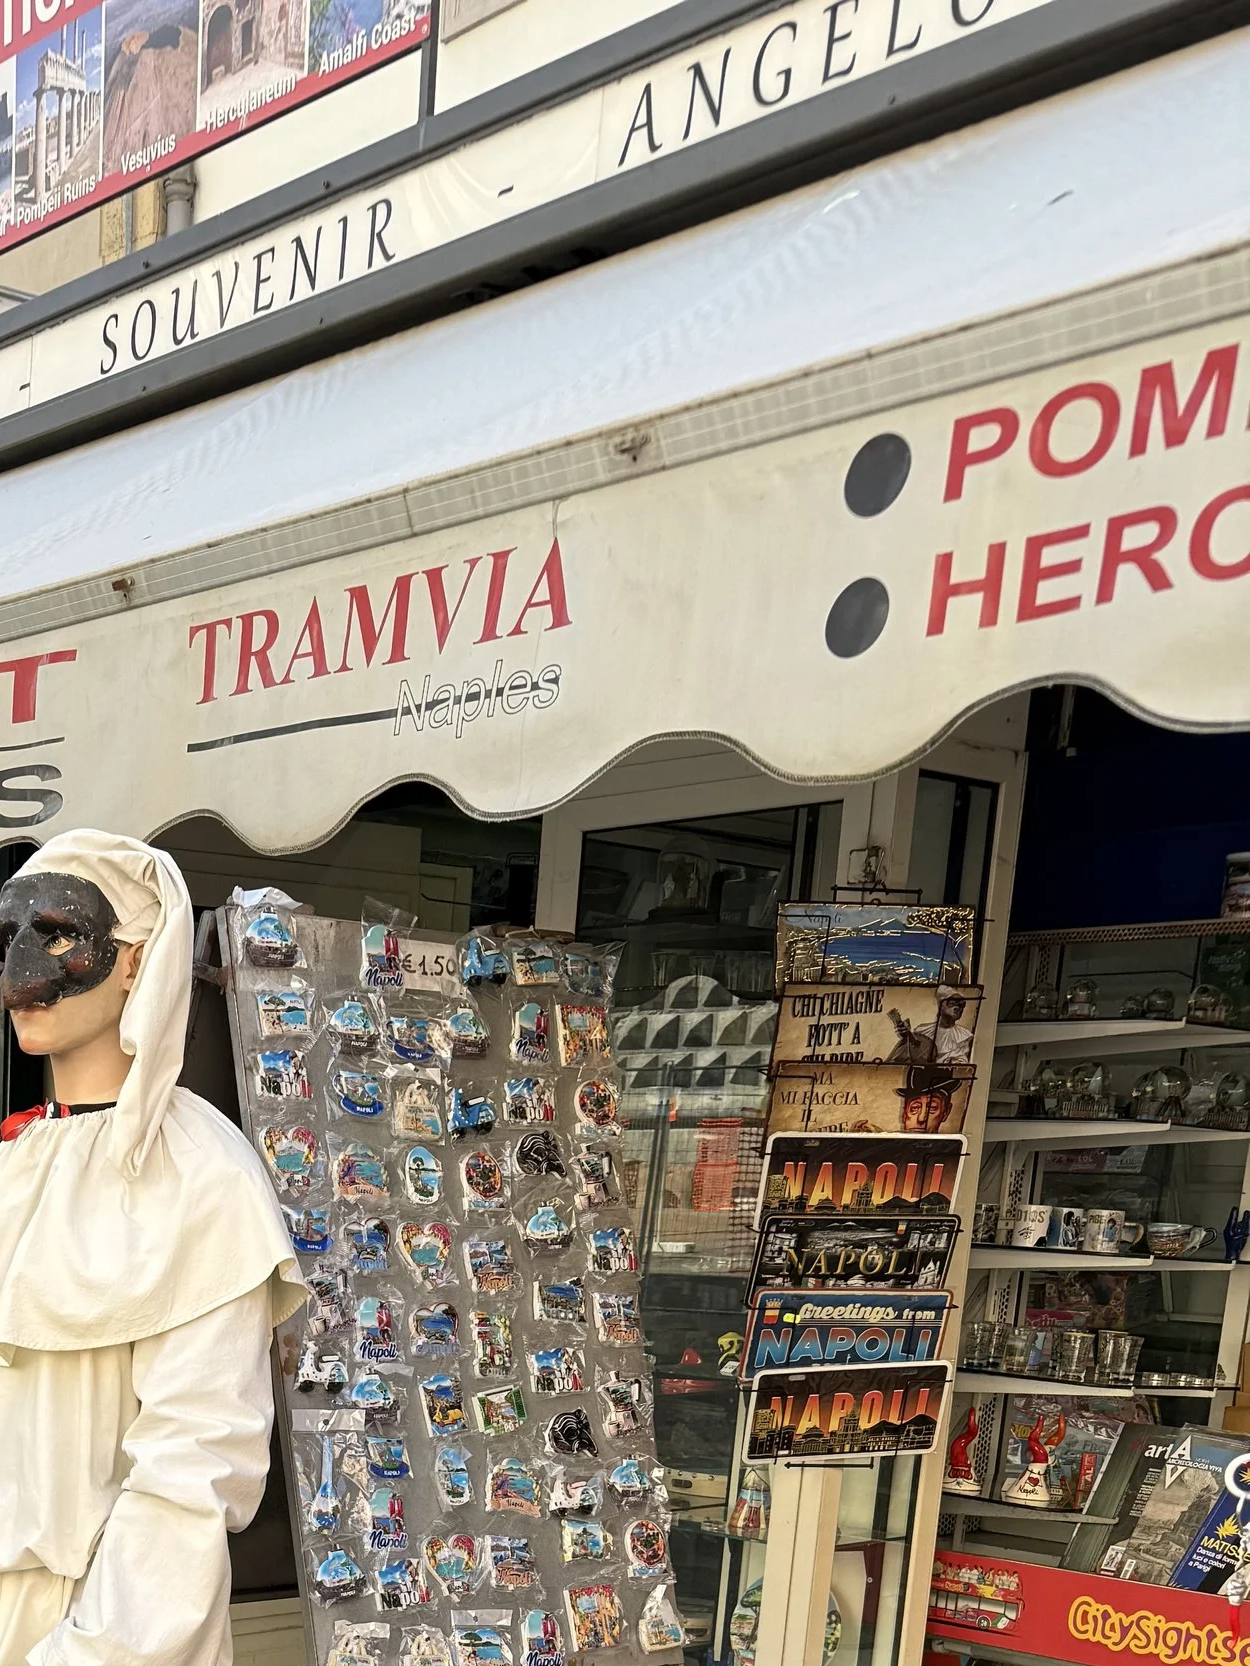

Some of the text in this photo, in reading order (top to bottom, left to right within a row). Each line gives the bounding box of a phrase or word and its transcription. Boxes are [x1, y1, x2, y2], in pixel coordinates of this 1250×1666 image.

[318, 12, 417, 78] Amalfi Coast
[205, 73, 298, 134] Herculaneum
[121, 132, 177, 175] Vesuvius
[17, 176, 97, 228] Pompeii Ruins
[101, 199, 398, 376] SOUVENIR
[942, 342, 1250, 504] POM
[189, 538, 573, 705] TRAMVIA
[393, 660, 561, 738] Naples
[365, 966, 403, 990] Napoli
[791, 990, 885, 1018] CHI CHIAGNE
[851, 1020, 862, 1045] A
[515, 1037, 549, 1063] Napoli
[813, 1071, 835, 1086] MA
[780, 1091, 860, 1106] MI FACCIA
[784, 1161, 945, 1212] NAPOLI
[781, 1246, 924, 1277] NAPOLI
[798, 1302, 936, 1321] Greetings from
[359, 1339, 399, 1363] Napoli
[753, 1327, 933, 1369] NAPOLI
[768, 1388, 931, 1435] NAPOLI
[1166, 1457, 1209, 1471] ARCHEOLOGIA
[1192, 1553, 1203, 1563] luci
[1207, 1558, 1227, 1570] colori
[1192, 1560, 1212, 1573] Parigi
[1196, 1545, 1215, 1559] Danza
